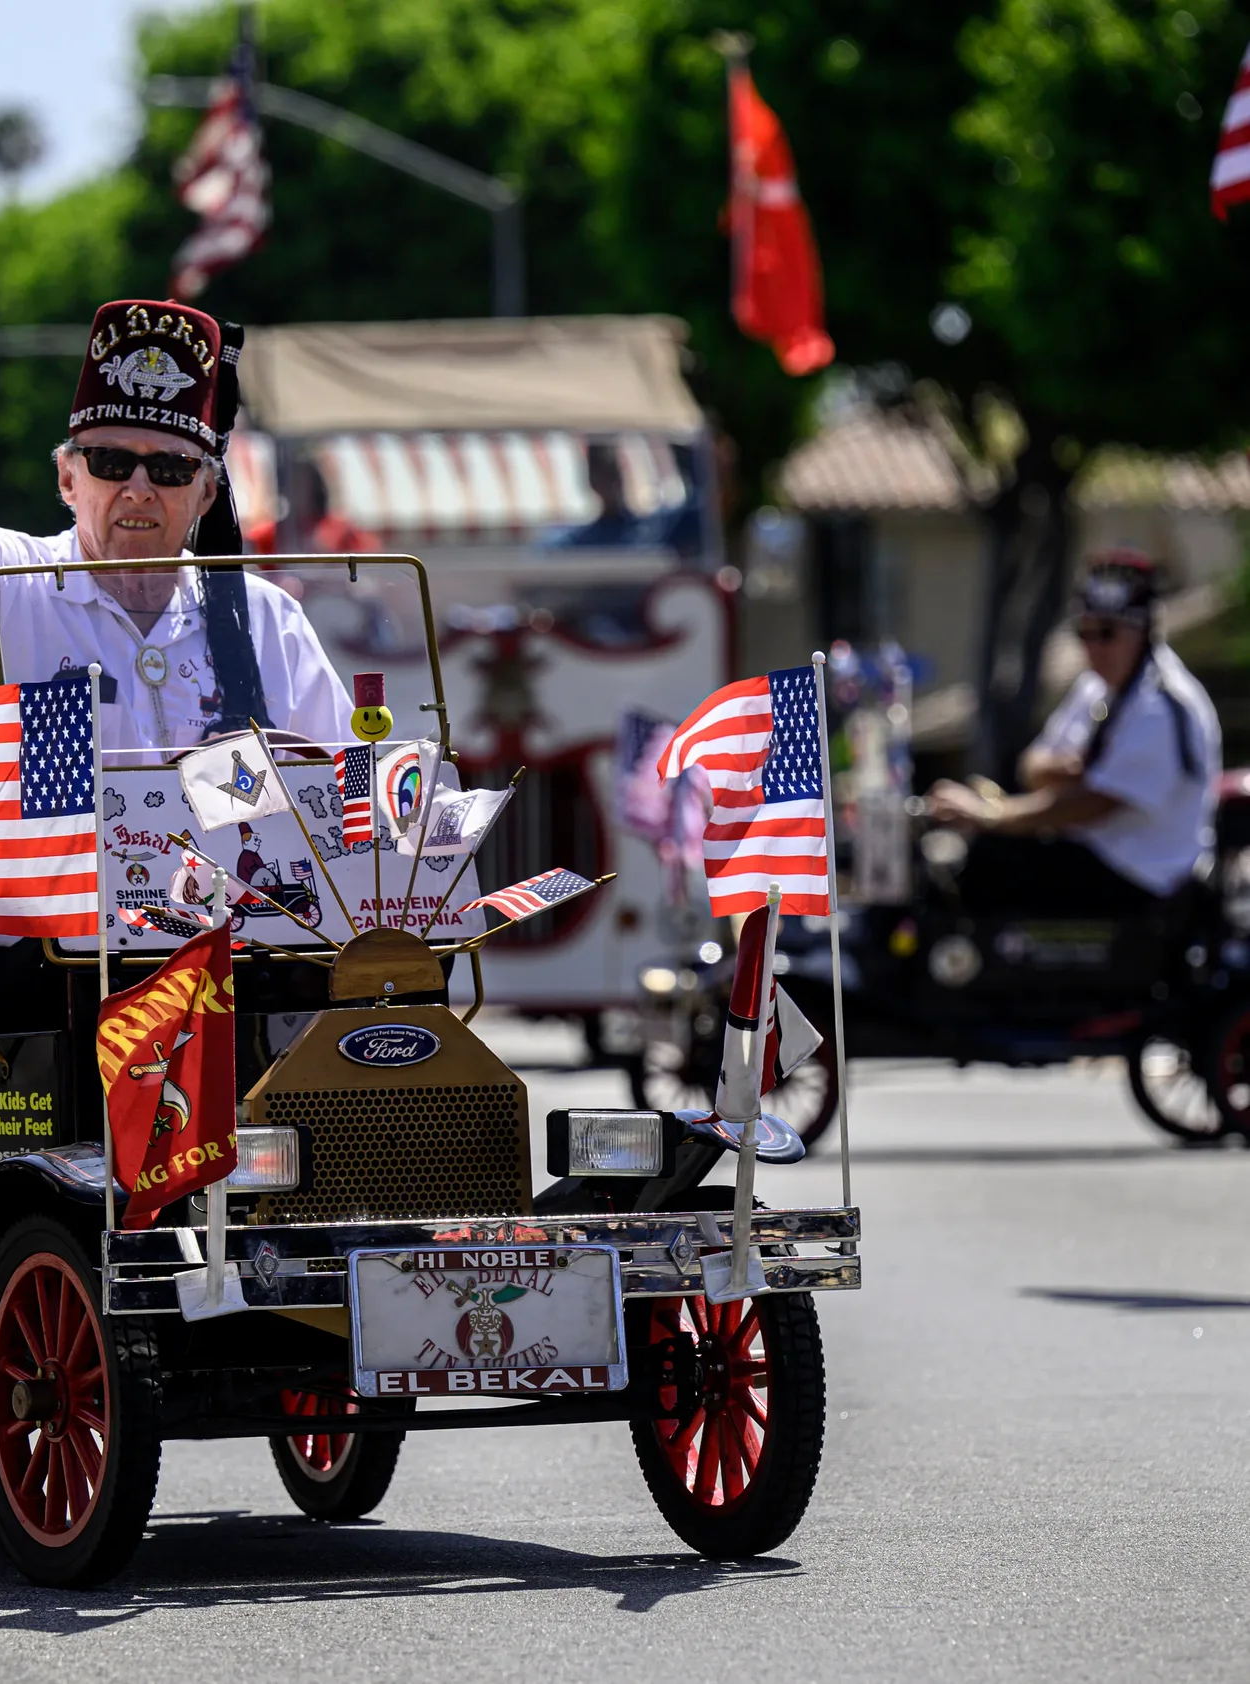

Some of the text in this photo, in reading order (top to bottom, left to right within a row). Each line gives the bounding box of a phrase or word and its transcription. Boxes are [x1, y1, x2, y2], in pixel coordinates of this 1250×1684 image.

[91, 322, 121, 361] El
[96, 404, 124, 419] TIN
[125, 405, 199, 433] LIZZIES
[187, 718, 207, 728] TIN
[116, 889, 167, 900] SHRINE
[364, 1038, 418, 1059] Ford
[0, 1091, 26, 1111] Kids
[30, 1092, 53, 1111] Get
[25, 1117, 53, 1136] Feet
[172, 1141, 224, 1173] FOR
[418, 1251, 550, 1268] HI NOBLE
[411, 1270, 446, 1299] EL
[414, 1338, 460, 1369] TIN
[379, 1367, 605, 1393] EL BEKAL
